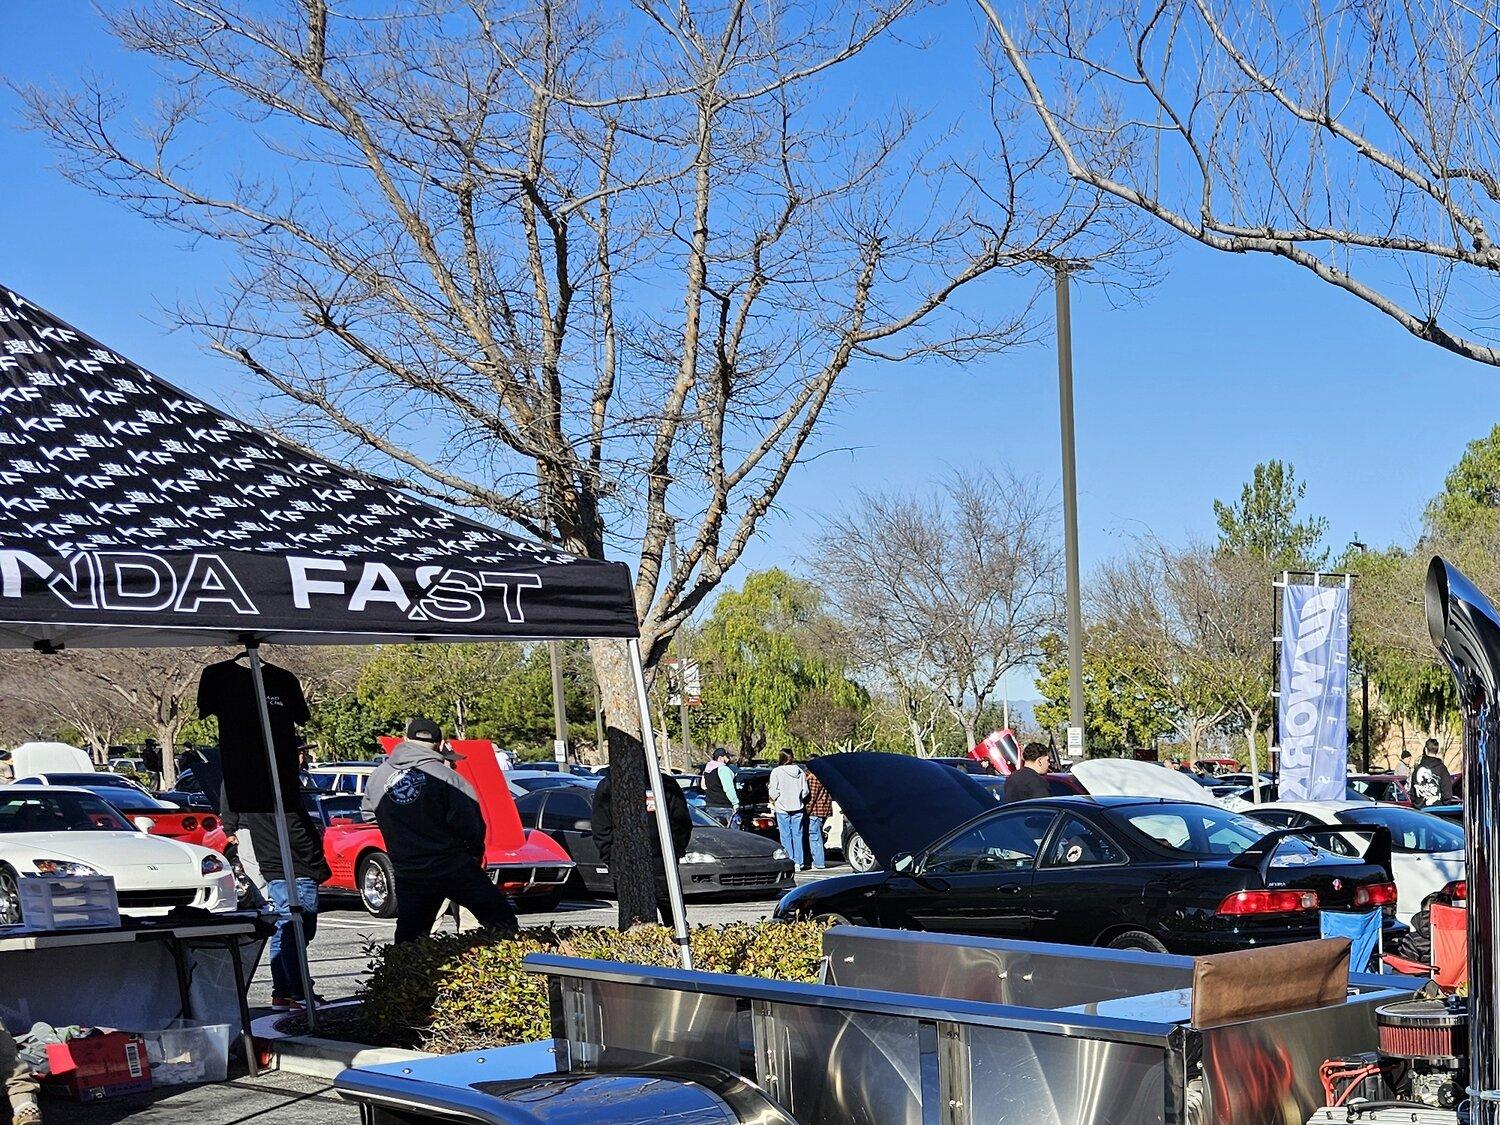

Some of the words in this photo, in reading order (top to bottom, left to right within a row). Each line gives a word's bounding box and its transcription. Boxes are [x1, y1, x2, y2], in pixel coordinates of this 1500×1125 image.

[8, 292, 39, 311] K
[32, 325, 79, 343] KF
[4, 339, 52, 354] 速い
[0, 356, 19, 371] F
[56, 356, 104, 375] KF
[27, 371, 76, 386] 速い
[112, 378, 157, 394] 速い
[0, 387, 42, 402] KF
[80, 388, 127, 405] KF
[50, 403, 99, 418] 速い
[162, 398, 207, 414] KF
[136, 409, 182, 424] 速い
[15, 418, 66, 431] KF
[103, 420, 151, 436] KF
[74, 434, 123, 448] 速い
[186, 427, 231, 442] KF
[40, 446, 90, 461] KF
[160, 439, 206, 454] 速い
[240, 446, 284, 459] 速い
[127, 450, 176, 465] KF
[210, 456, 255, 471] KF
[9, 459, 60, 474] 速い
[99, 463, 148, 477] 速い
[287, 462, 331, 476] KF
[0, 471, 25, 485] F
[64, 475, 115, 489] KF
[184, 468, 230, 482] 速い
[264, 474, 308, 487] 速い
[152, 478, 200, 493] KF
[234, 483, 280, 498] KF
[34, 487, 85, 500] 速い
[123, 491, 173, 504] 速い
[208, 494, 255, 507] 速い
[312, 488, 356, 502] KF
[387, 492, 420, 505] K
[0, 497, 50, 512] KF
[89, 502, 140, 515] KF
[288, 500, 332, 511] 速い
[364, 504, 407, 515] 速い
[59, 513, 111, 525] 速い
[177, 505, 225, 519] KF
[260, 509, 305, 522] KF
[149, 516, 198, 527] 速い
[234, 521, 281, 531] 速い
[338, 513, 381, 526] KF
[412, 517, 454, 529] KF
[22, 522, 76, 535] KF
[115, 527, 166, 538] KF
[203, 529, 251, 540] KF
[315, 523, 359, 534] 速い
[390, 527, 432, 538] 速い
[85, 535, 136, 544] 速い
[286, 532, 332, 542] KF
[364, 535, 407, 545] KF
[438, 538, 480, 550] KF
[286, 556, 543, 623] FAST
